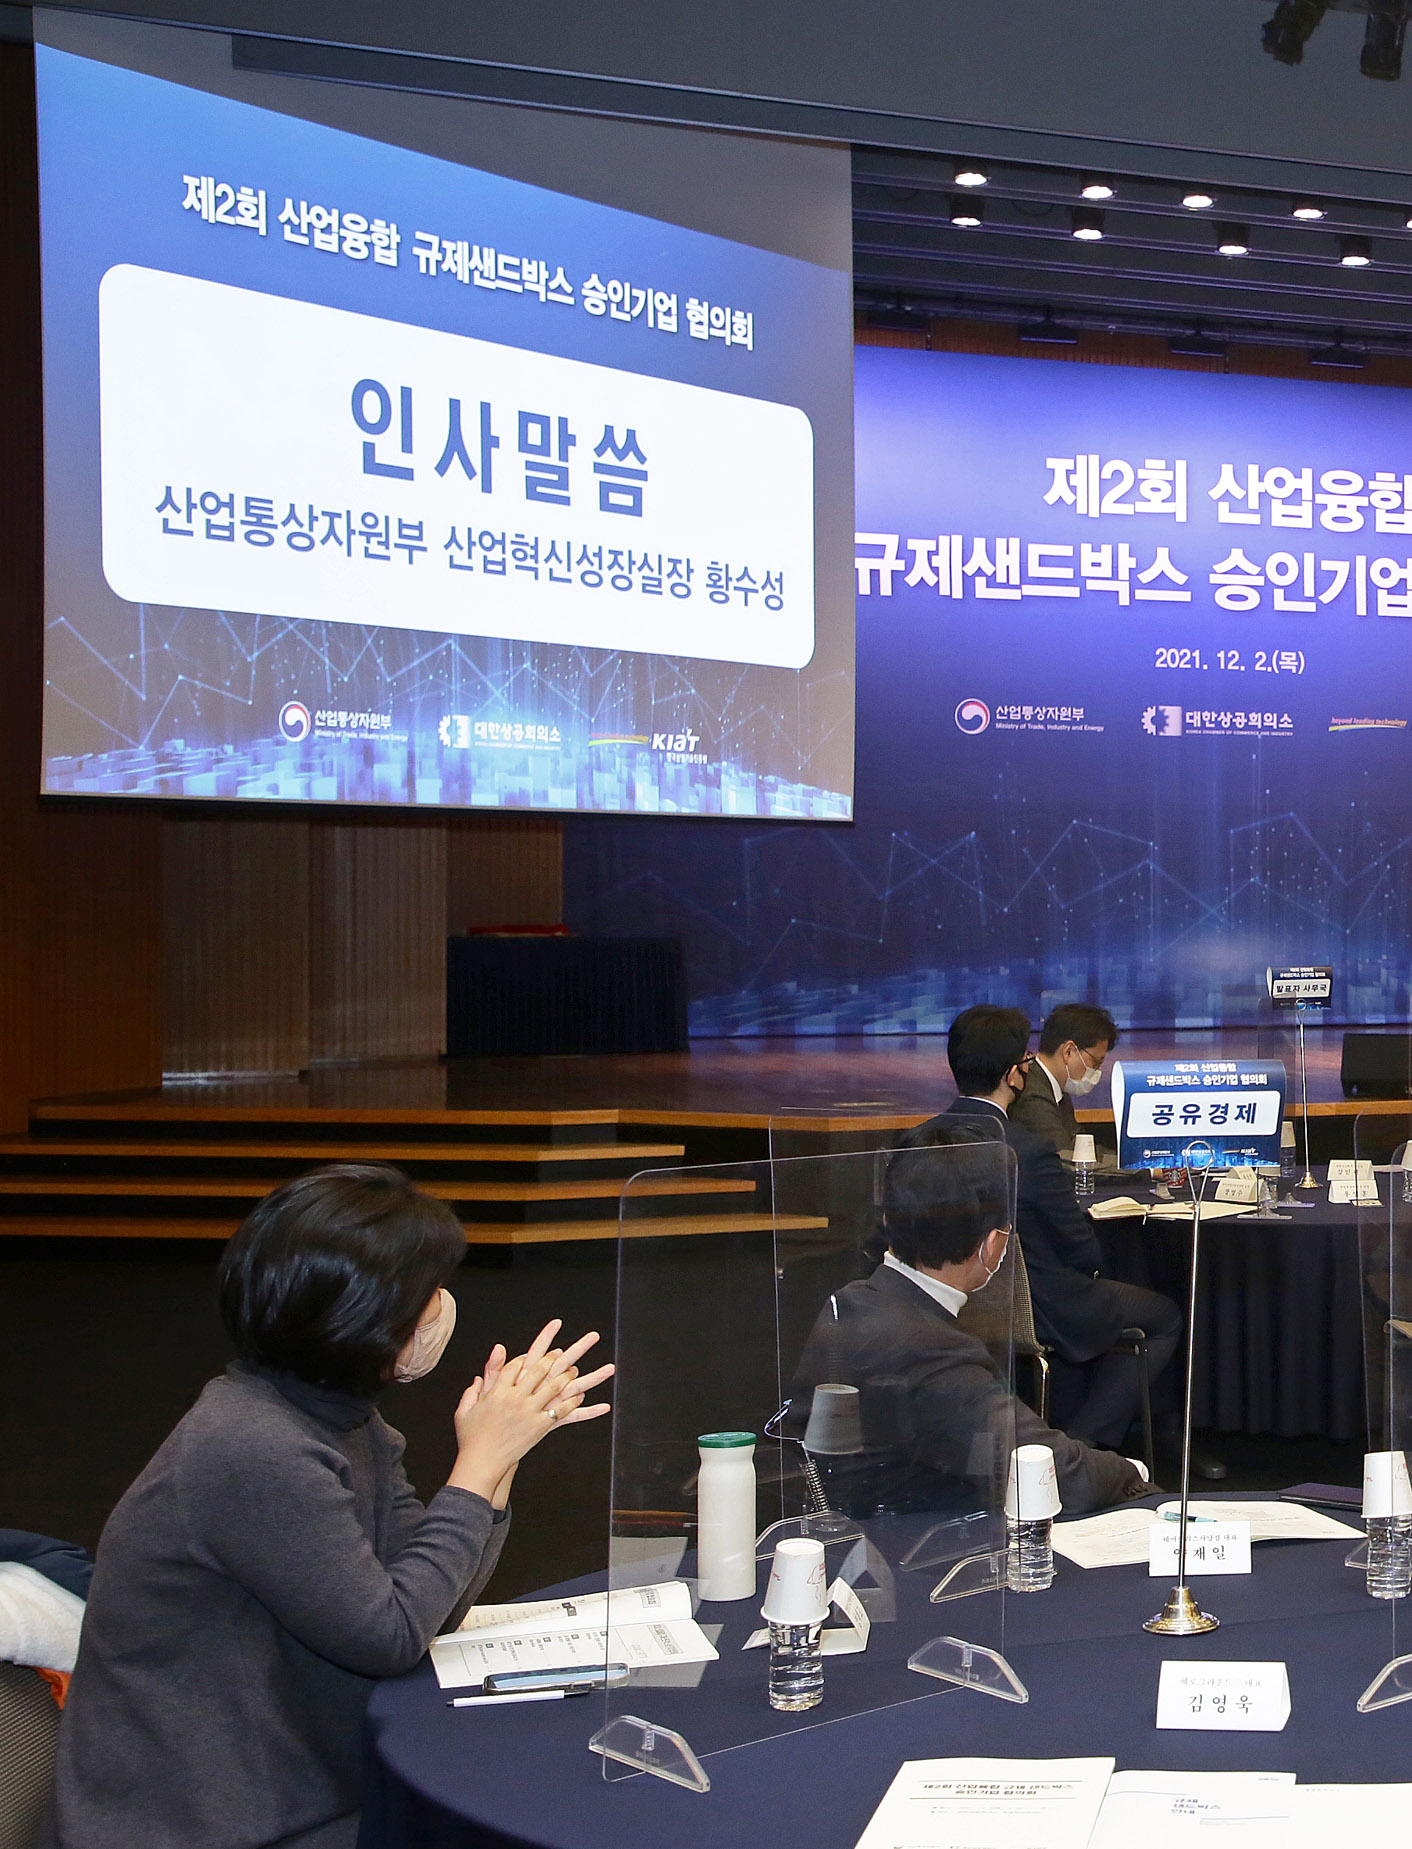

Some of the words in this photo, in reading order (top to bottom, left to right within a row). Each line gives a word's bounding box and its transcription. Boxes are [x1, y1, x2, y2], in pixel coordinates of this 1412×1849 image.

[182, 174, 267, 236] 제2회
[278, 198, 401, 267] 산업융합
[412, 231, 575, 306] 규제샌드박스
[581, 273, 679, 333] 승인기업
[685, 297, 754, 351] 협의회
[1043, 454, 1187, 522] 제2회
[155, 485, 428, 565] 산업통상자원부
[443, 526, 694, 599] 산업혁신성장실장
[705, 561, 784, 611] 황수성
[853, 532, 1192, 606] 규제샌드박스
[1155, 648, 1207, 670] 2021.
[1217, 650, 1246, 671] 12.
[1254, 650, 1305, 674] 2.(목)
[315, 710, 392, 730] 산업통상자원부
[996, 705, 1085, 722] 산업통상자원부
[1185, 711, 1294, 729] 대한상공회의소
[474, 721, 561, 743] 대한상공회의소
[995, 722, 1019, 731] Ministry
[1047, 724, 1071, 732] Industry
[1084, 725, 1104, 733] Energy
[1151, 1102, 1257, 1126] 공유경제
[1188, 1693, 1253, 1714] 김영욱
